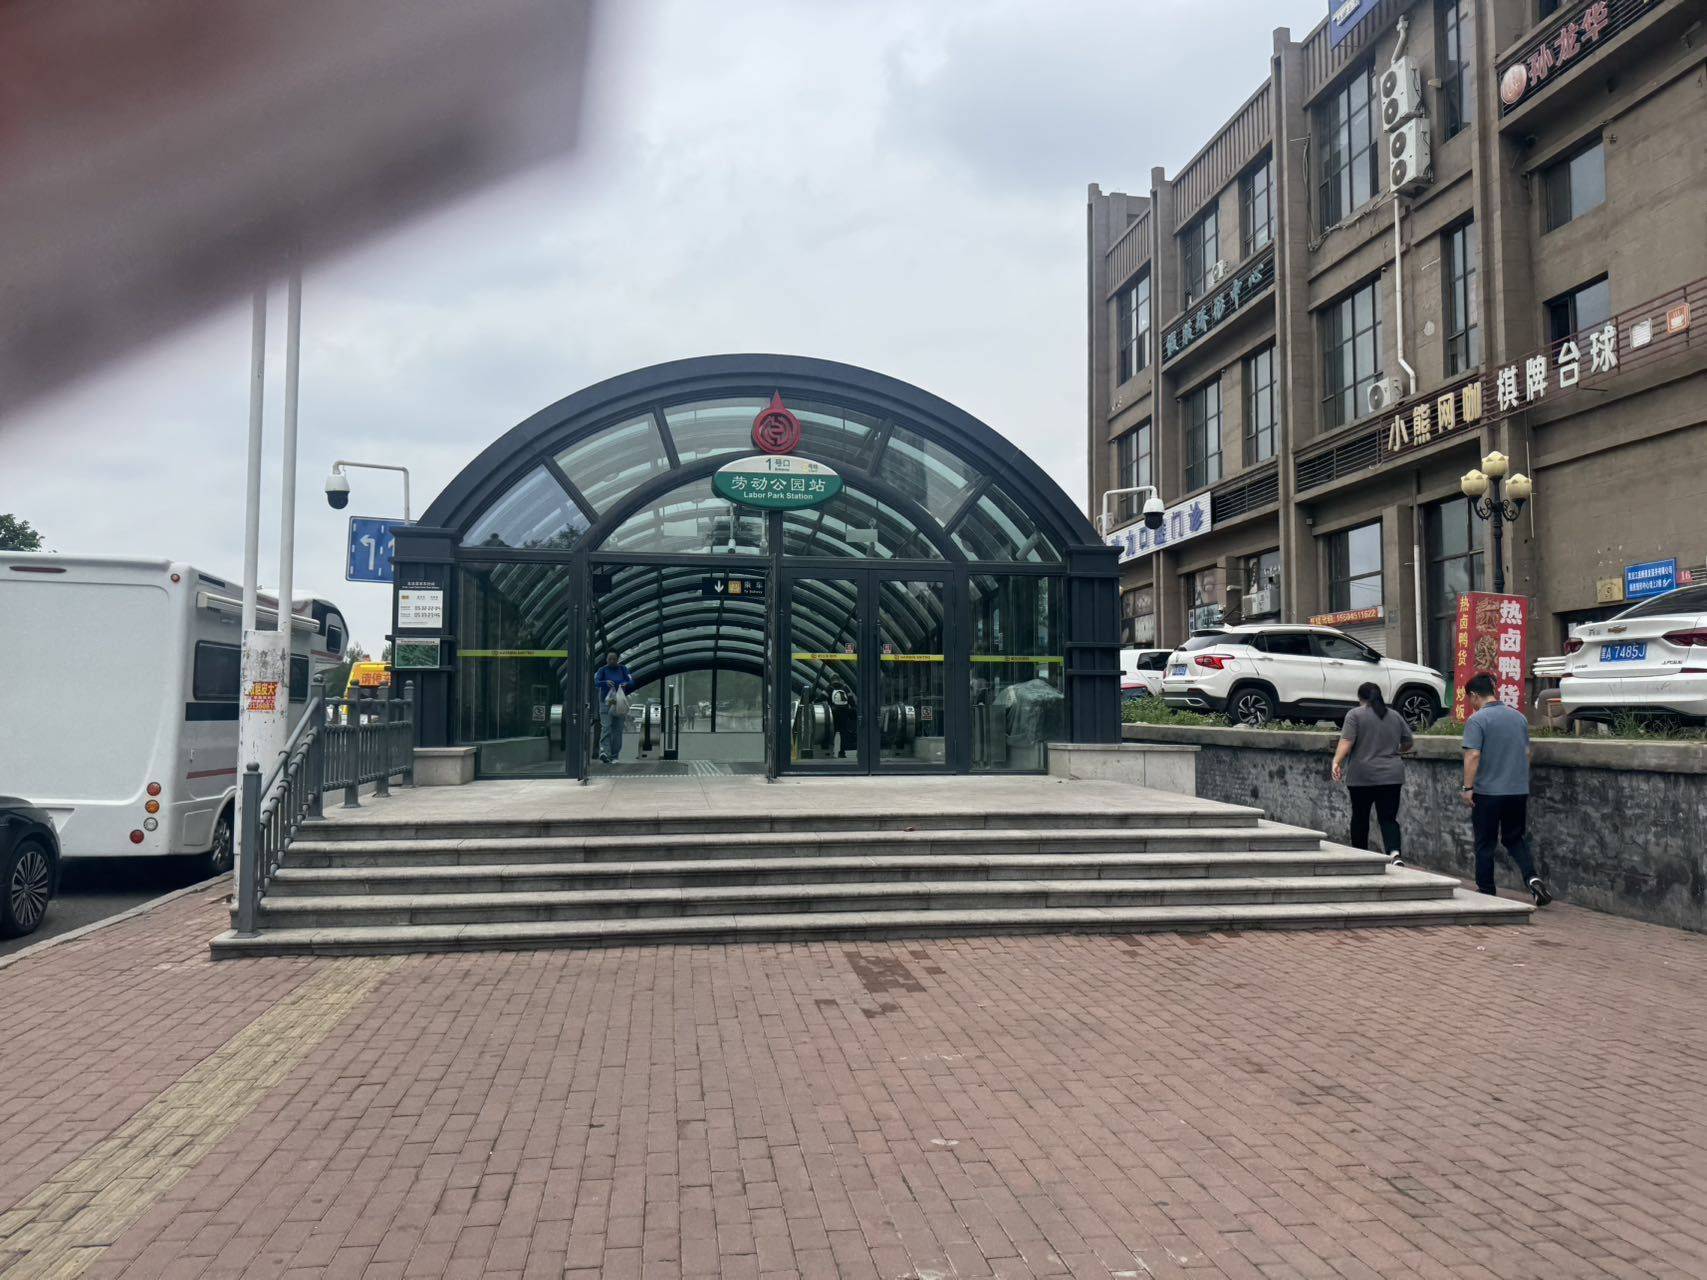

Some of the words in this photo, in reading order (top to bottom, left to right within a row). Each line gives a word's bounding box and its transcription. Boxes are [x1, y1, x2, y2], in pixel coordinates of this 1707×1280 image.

[1387, 382, 1482, 452] 小熊网咖
[1496, 323, 1618, 412] 棋牌台球
[731, 476, 826, 492] 劳动公园站
[743, 491, 766, 499] Labor
[786, 492, 813, 500] Station
[1498, 600, 1522, 709] 热卤鸭货
